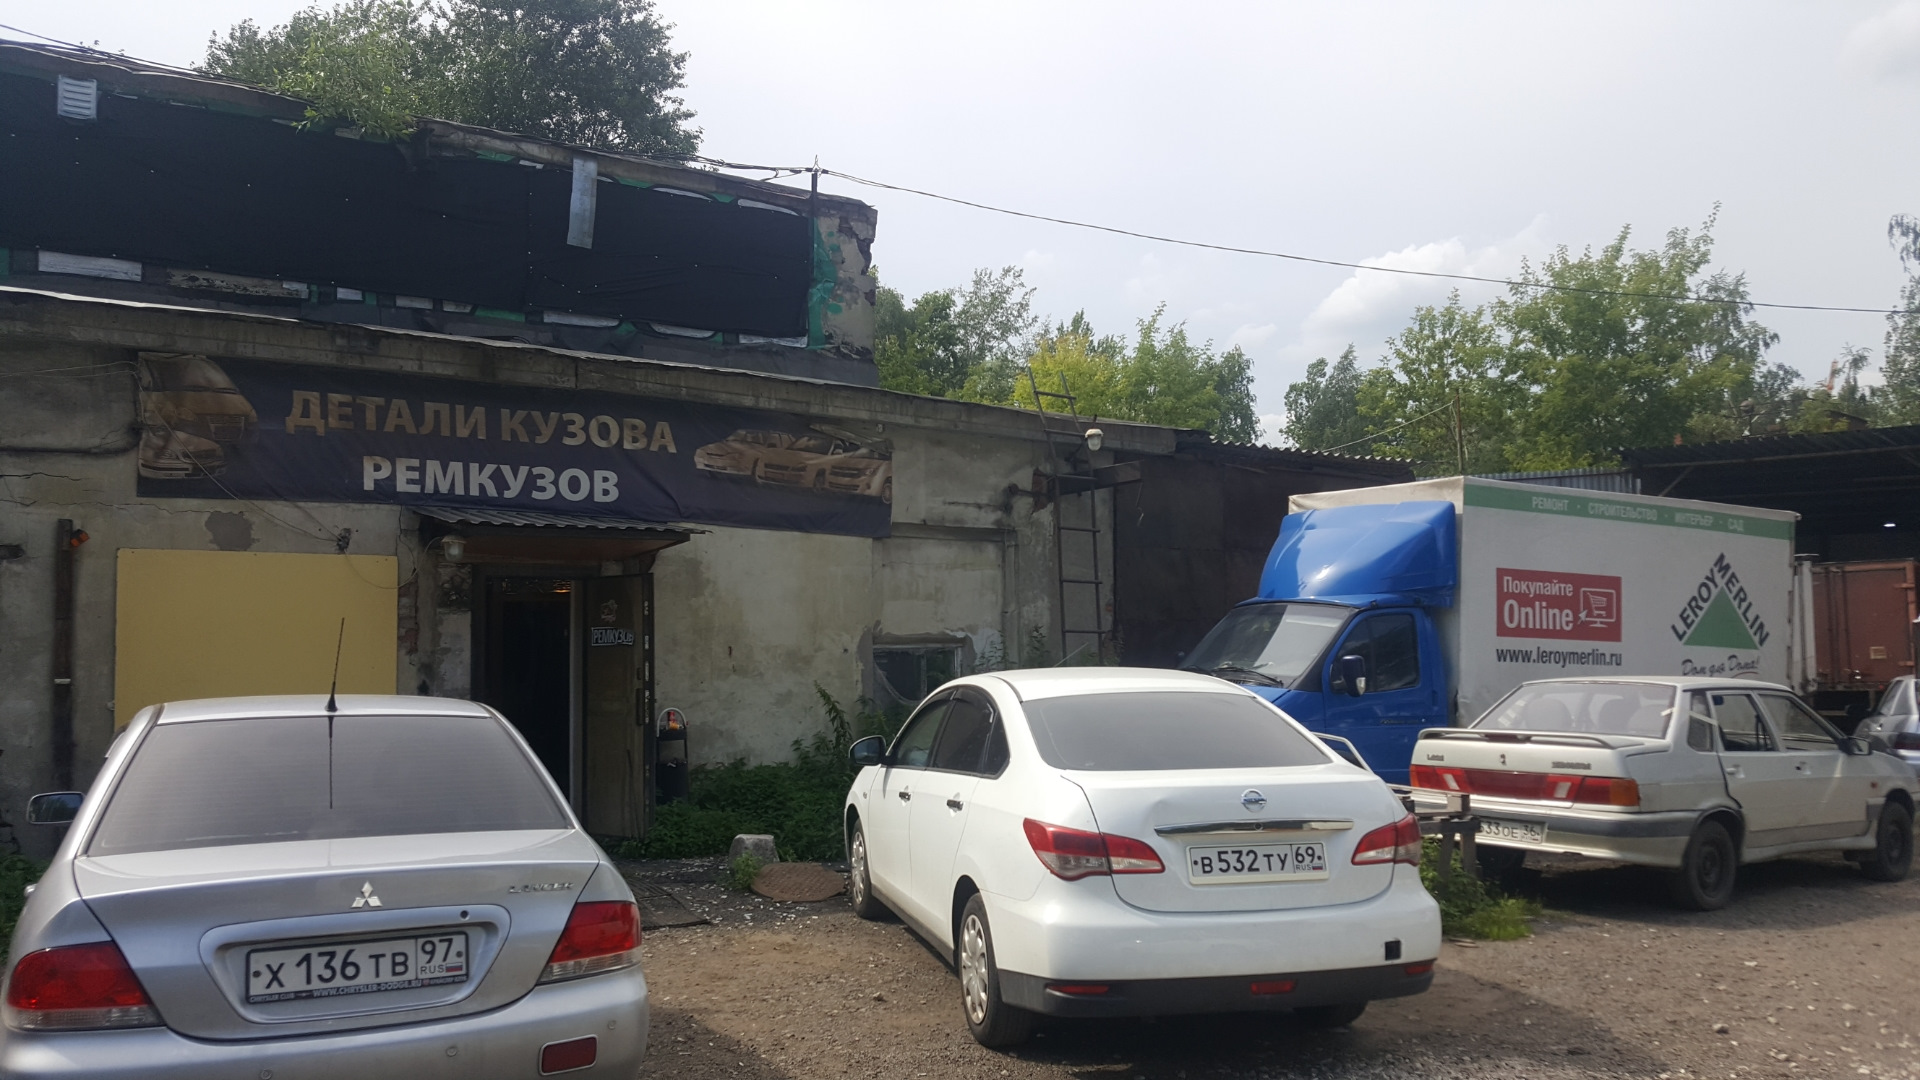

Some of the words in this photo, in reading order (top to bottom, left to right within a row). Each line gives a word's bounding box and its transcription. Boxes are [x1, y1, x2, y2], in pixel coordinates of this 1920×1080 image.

[285, 390, 487, 439] ДЕТАЛИ
[501, 408, 678, 454] КУЗОВА
[362, 456, 620, 502] РЕМКУЗОВ
[1532, 496, 1569, 511] РЕМОНТ
[1588, 502, 1658, 521] СТРОИТЕЛЬСТВО
[1675, 512, 1714, 527] ИНТЕРЬЕР
[1727, 518, 1745, 532] САД
[1503, 576, 1574, 598] Покупайте
[1713, 552, 1770, 647] MERLIN
[1503, 599, 1574, 631] Online
[1671, 568, 1718, 642] LEROY
[1496, 646, 1622, 668] www.leroymerlin.ru
[1294, 846, 1316, 864] 69
[420, 938, 454, 964] 97
[420, 964, 445, 975] RUS
[312, 979, 422, 998] WWW.CHRYSLER-DODGE.RU
